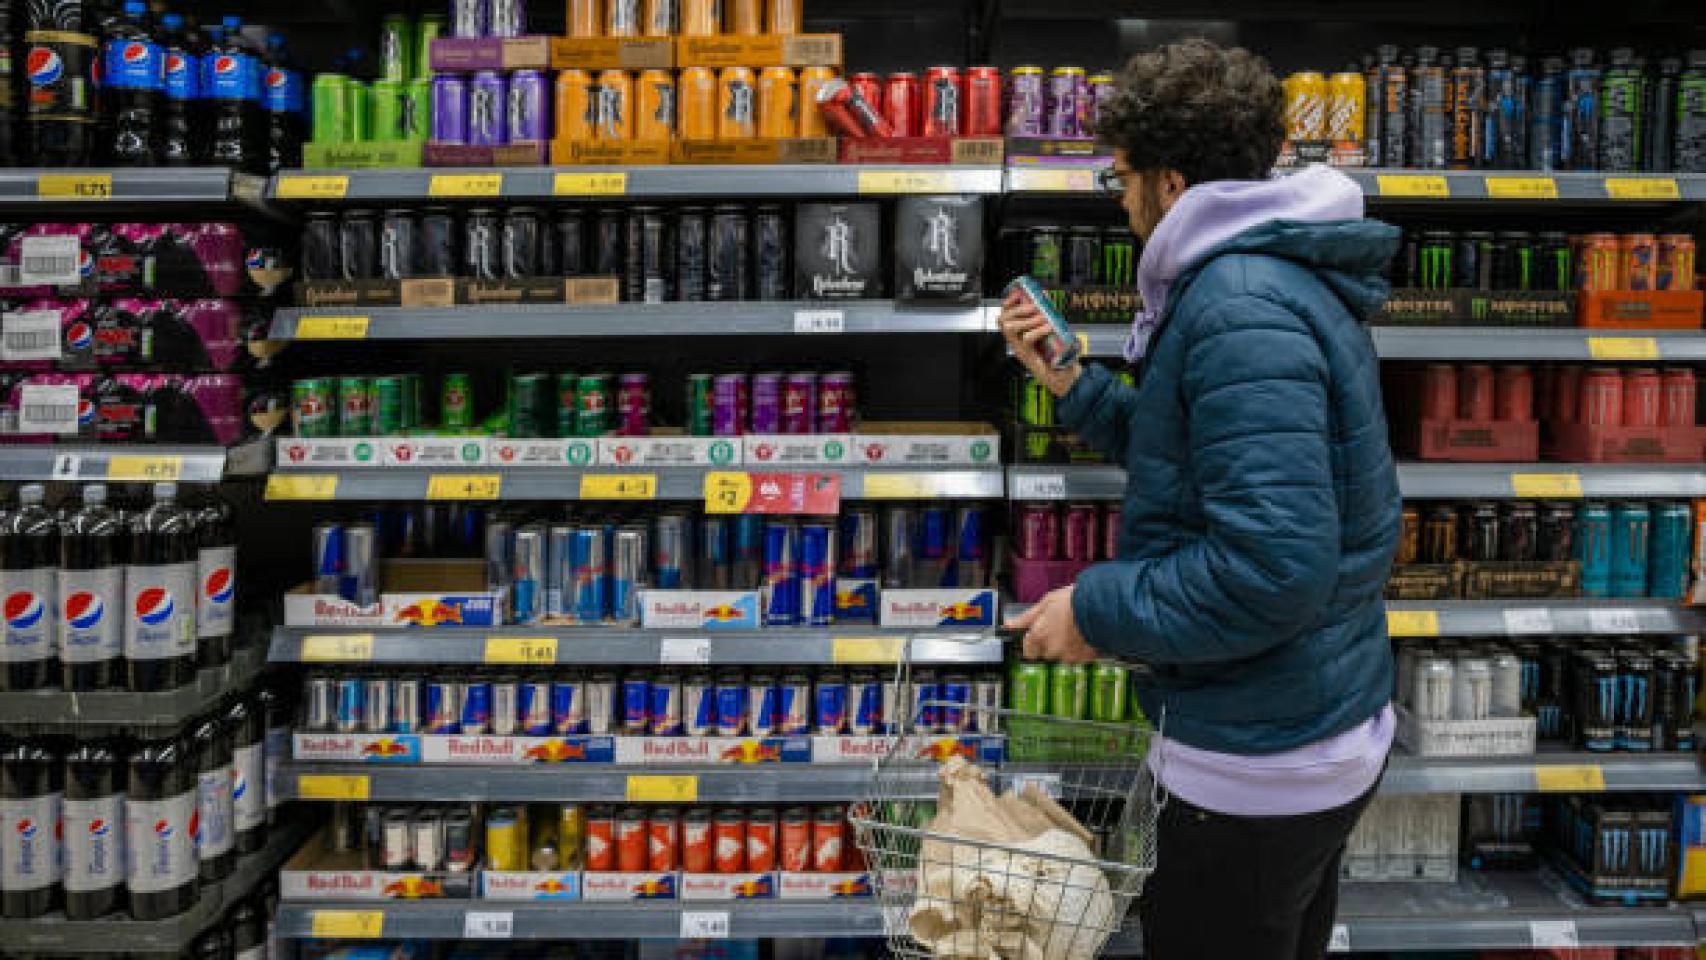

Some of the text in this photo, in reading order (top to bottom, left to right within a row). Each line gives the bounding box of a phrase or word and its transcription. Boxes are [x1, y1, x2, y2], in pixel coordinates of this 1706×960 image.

[449, 739, 514, 754] Red Bull
[643, 740, 709, 755] Red Bull
